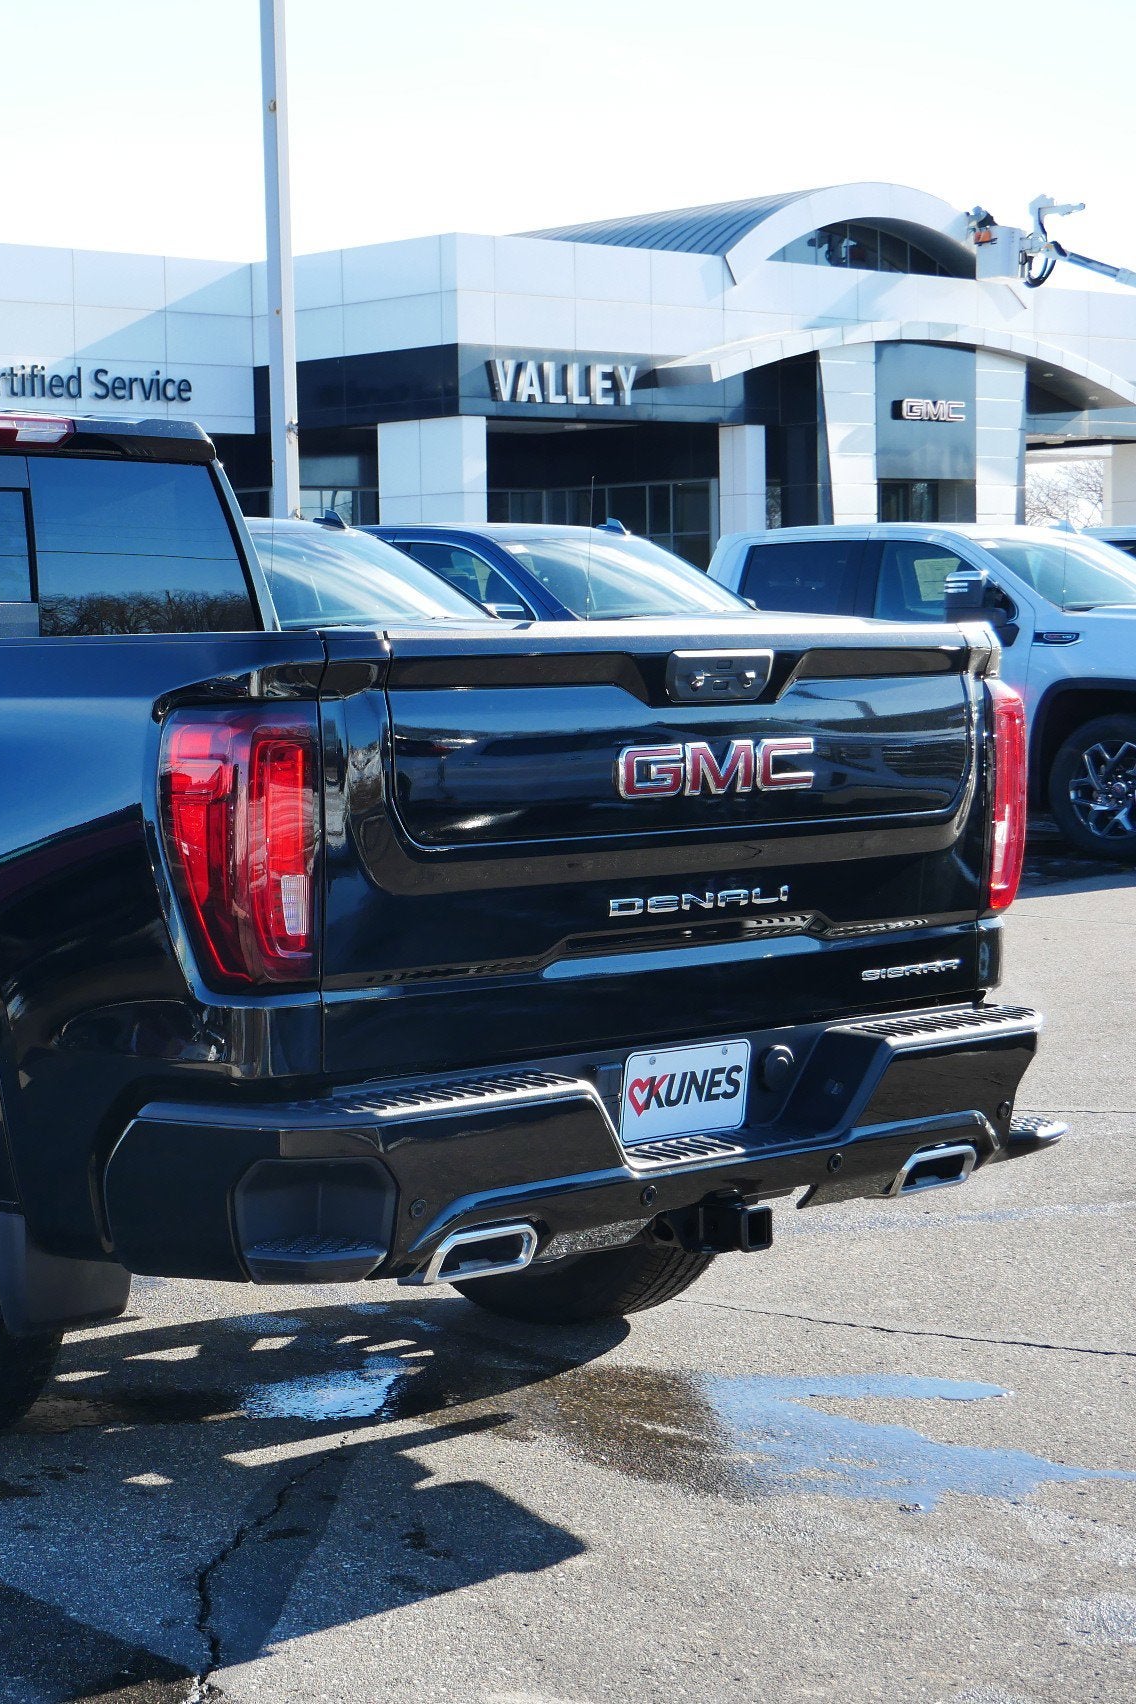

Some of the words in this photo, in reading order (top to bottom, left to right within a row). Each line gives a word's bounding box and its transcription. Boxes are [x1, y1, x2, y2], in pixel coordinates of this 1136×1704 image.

[93, 367, 193, 402] Service
[486, 358, 638, 406] VALLEY
[900, 398, 966, 422] GMC
[617, 736, 815, 800] GMC
[608, 884, 790, 918] DENALI
[861, 958, 961, 982] SIERRA
[641, 1063, 745, 1111] KUNES
